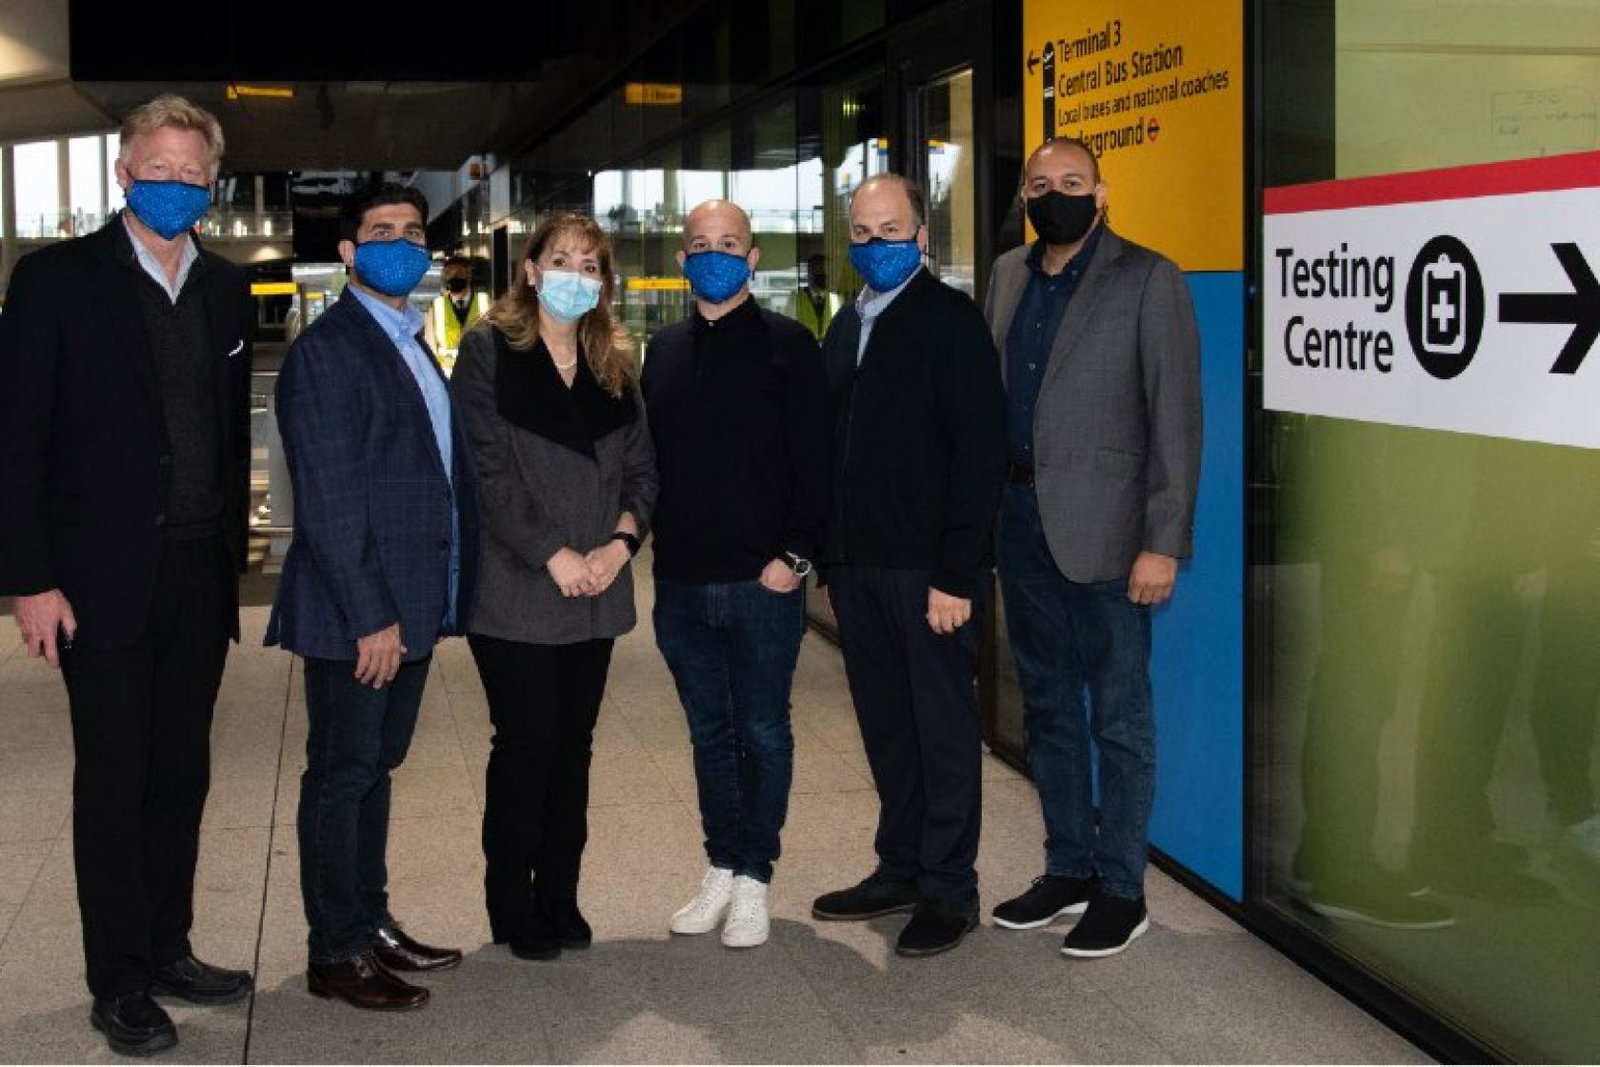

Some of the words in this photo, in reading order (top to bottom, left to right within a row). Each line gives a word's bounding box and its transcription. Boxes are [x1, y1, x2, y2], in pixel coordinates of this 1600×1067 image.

[1058, 22, 1111, 62] Terminal
[1113, 18, 1121, 46] 3
[1058, 63, 1101, 98] Central
[1105, 60, 1128, 86] Bus
[1131, 43, 1183, 77] Station
[1058, 100, 1081, 127] Local
[1083, 98, 1111, 121] buses
[1112, 91, 1131, 114] and
[1133, 77, 1178, 108] national
[1180, 69, 1229, 98] coaches
[1275, 243, 1395, 313] Testing
[1284, 316, 1394, 373] Centre
